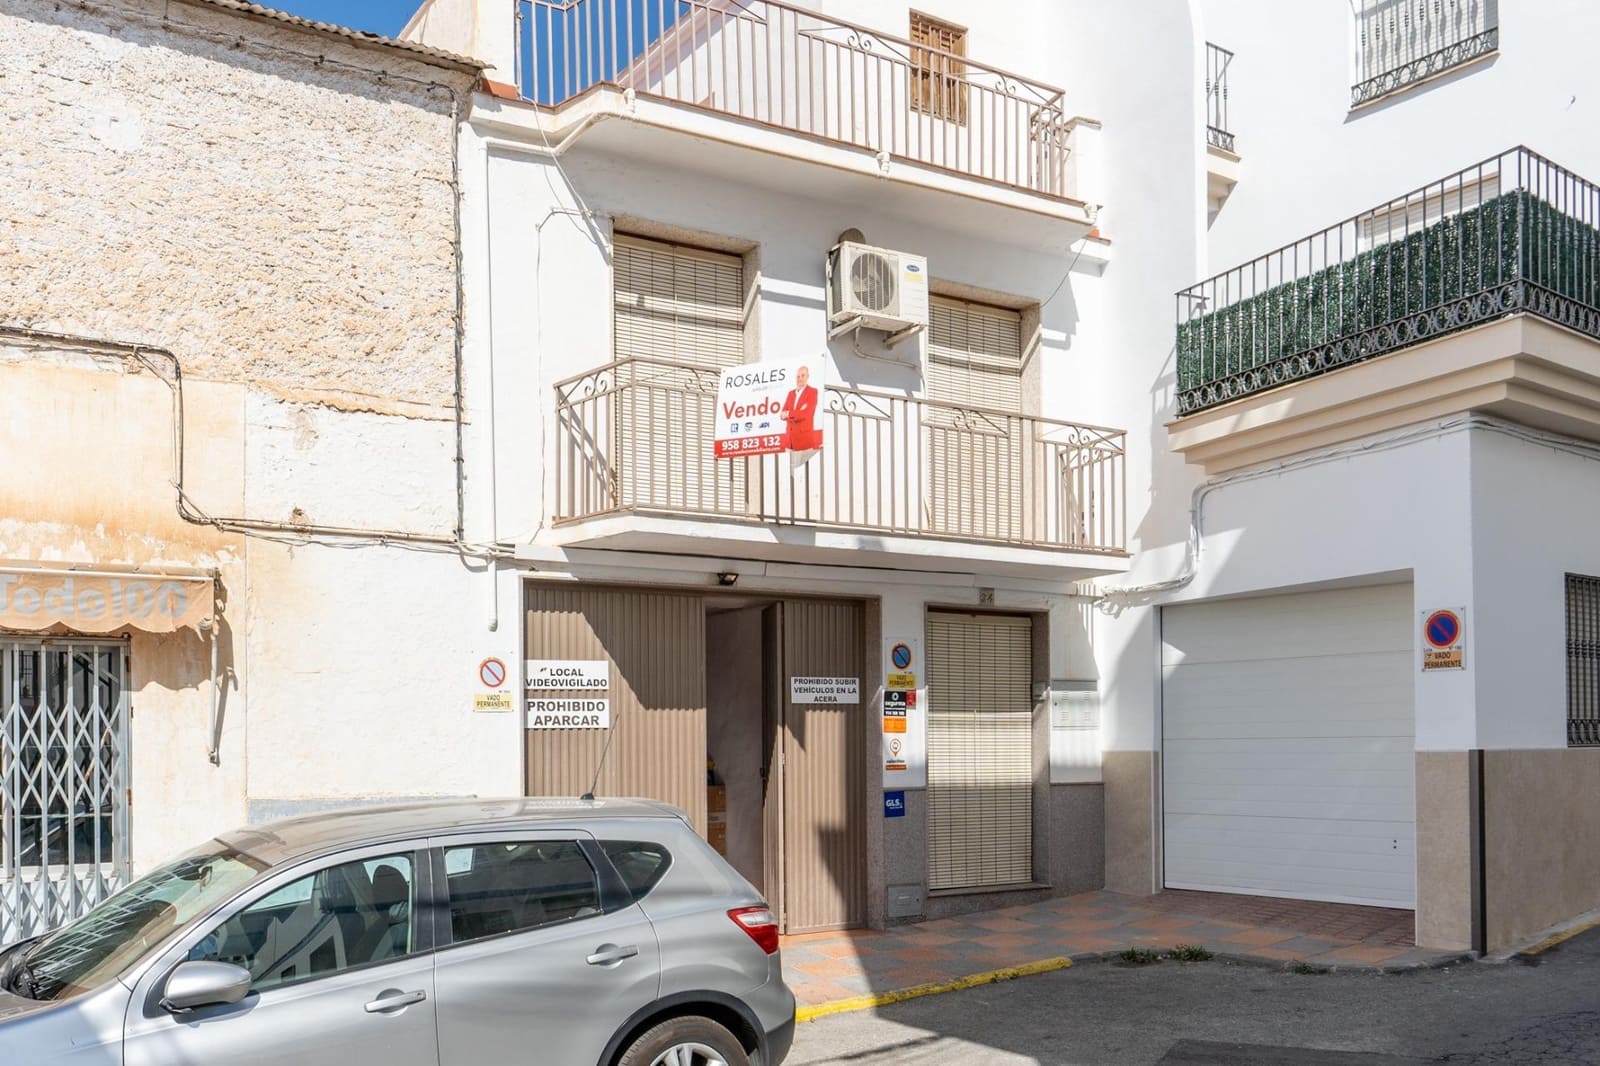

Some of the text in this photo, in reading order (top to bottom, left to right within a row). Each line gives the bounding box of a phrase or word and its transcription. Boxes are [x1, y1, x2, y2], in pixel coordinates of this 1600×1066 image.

[725, 368, 786, 390] ROSALES
[723, 396, 781, 420] Vendo
[721, 435, 781, 451] 958 823 132
[1435, 651, 1451, 660] VADO
[1424, 660, 1462, 669] PERMANENTE
[549, 668, 584, 677] LOCAL
[526, 678, 608, 688] VIDEOVIGILADO
[527, 701, 606, 712] PROHIBIDO
[534, 715, 600, 726] APARCAR
[886, 799, 901, 807] GLS
